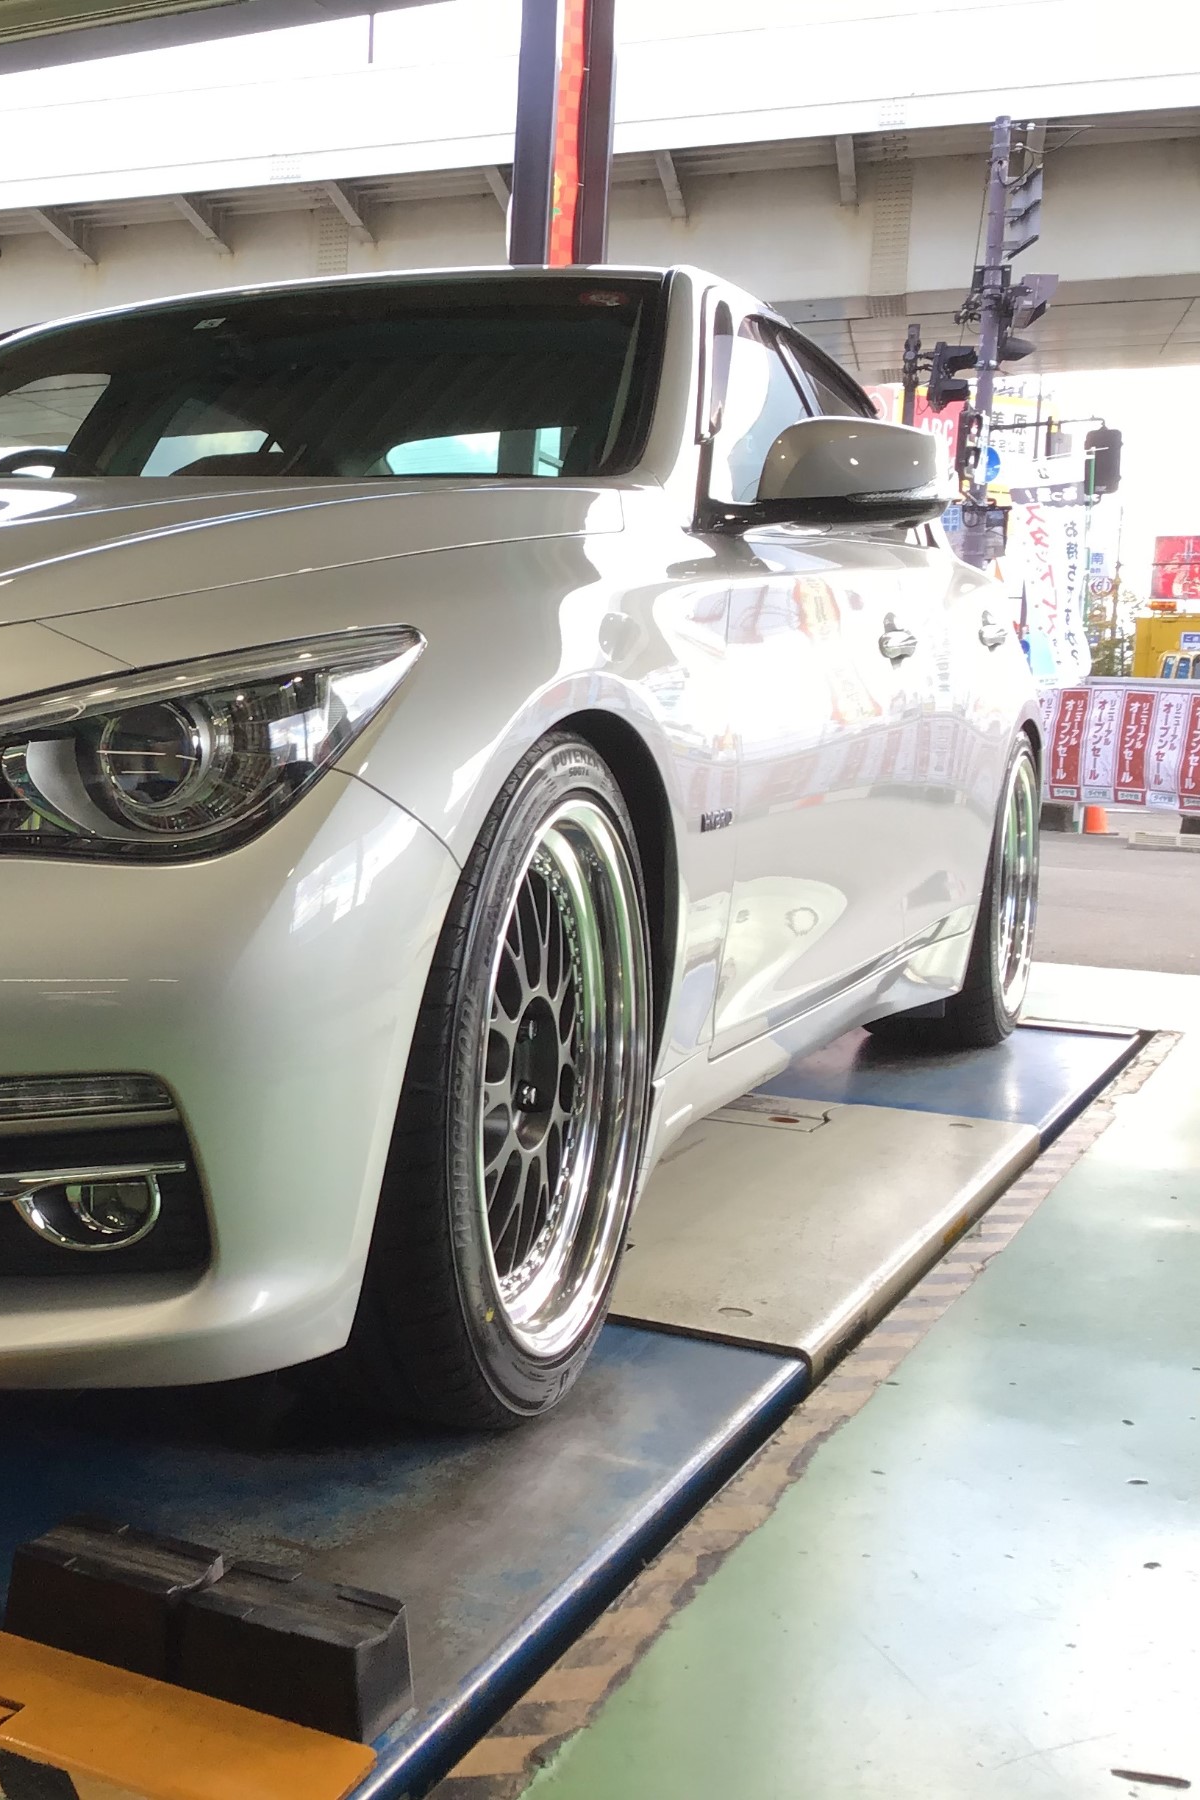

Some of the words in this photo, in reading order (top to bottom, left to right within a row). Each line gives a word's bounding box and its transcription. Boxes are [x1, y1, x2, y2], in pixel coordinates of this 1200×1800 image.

[1056, 698, 1076, 780] オープンセール
[1070, 699, 1084, 746] リニューアル
[1088, 699, 1108, 781] オープンセール
[1104, 699, 1116, 746] リニューアル
[1121, 701, 1141, 784] オープンセール
[1135, 702, 1150, 750] リニューアル
[1153, 702, 1174, 786] オープンセール
[1169, 703, 1182, 751] リニューアル
